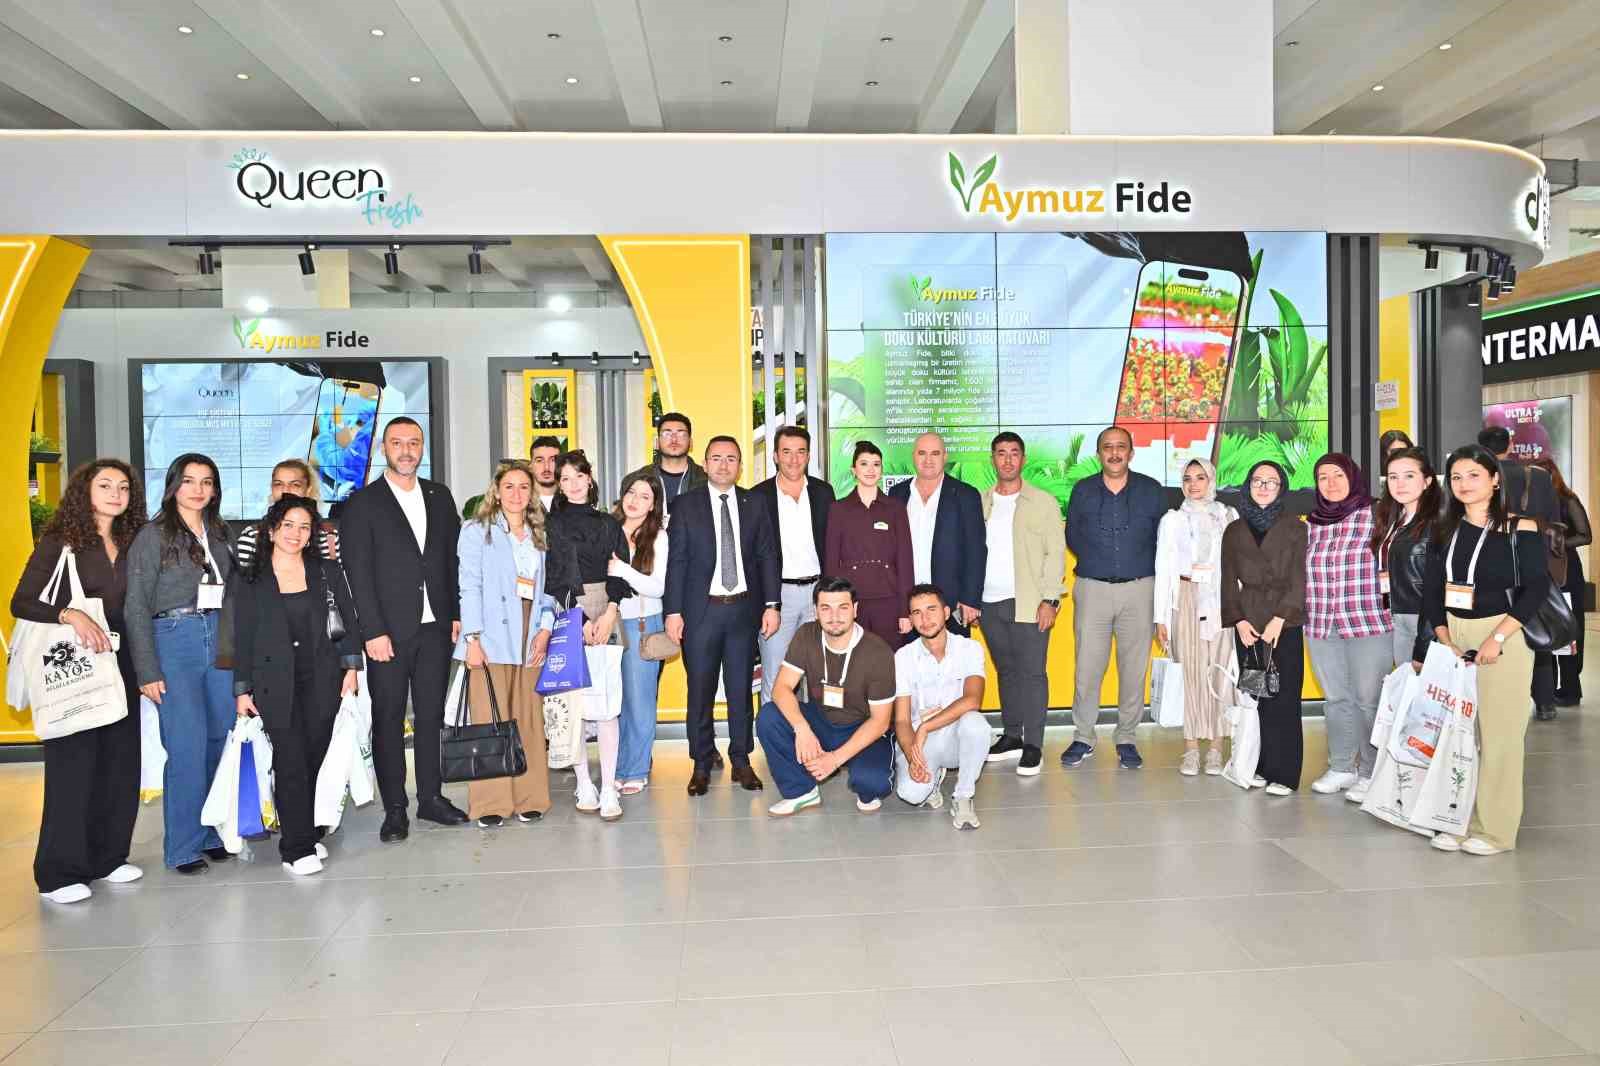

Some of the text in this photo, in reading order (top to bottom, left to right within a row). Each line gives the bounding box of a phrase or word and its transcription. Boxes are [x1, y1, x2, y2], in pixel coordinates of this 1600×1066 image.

[236, 162, 384, 208] Queen
[979, 181, 1192, 222] Aymuz Fide
[357, 190, 423, 228] Fresh
[922, 286, 1016, 304] Aymuz Fide
[249, 330, 369, 353] Aymuz Fide
